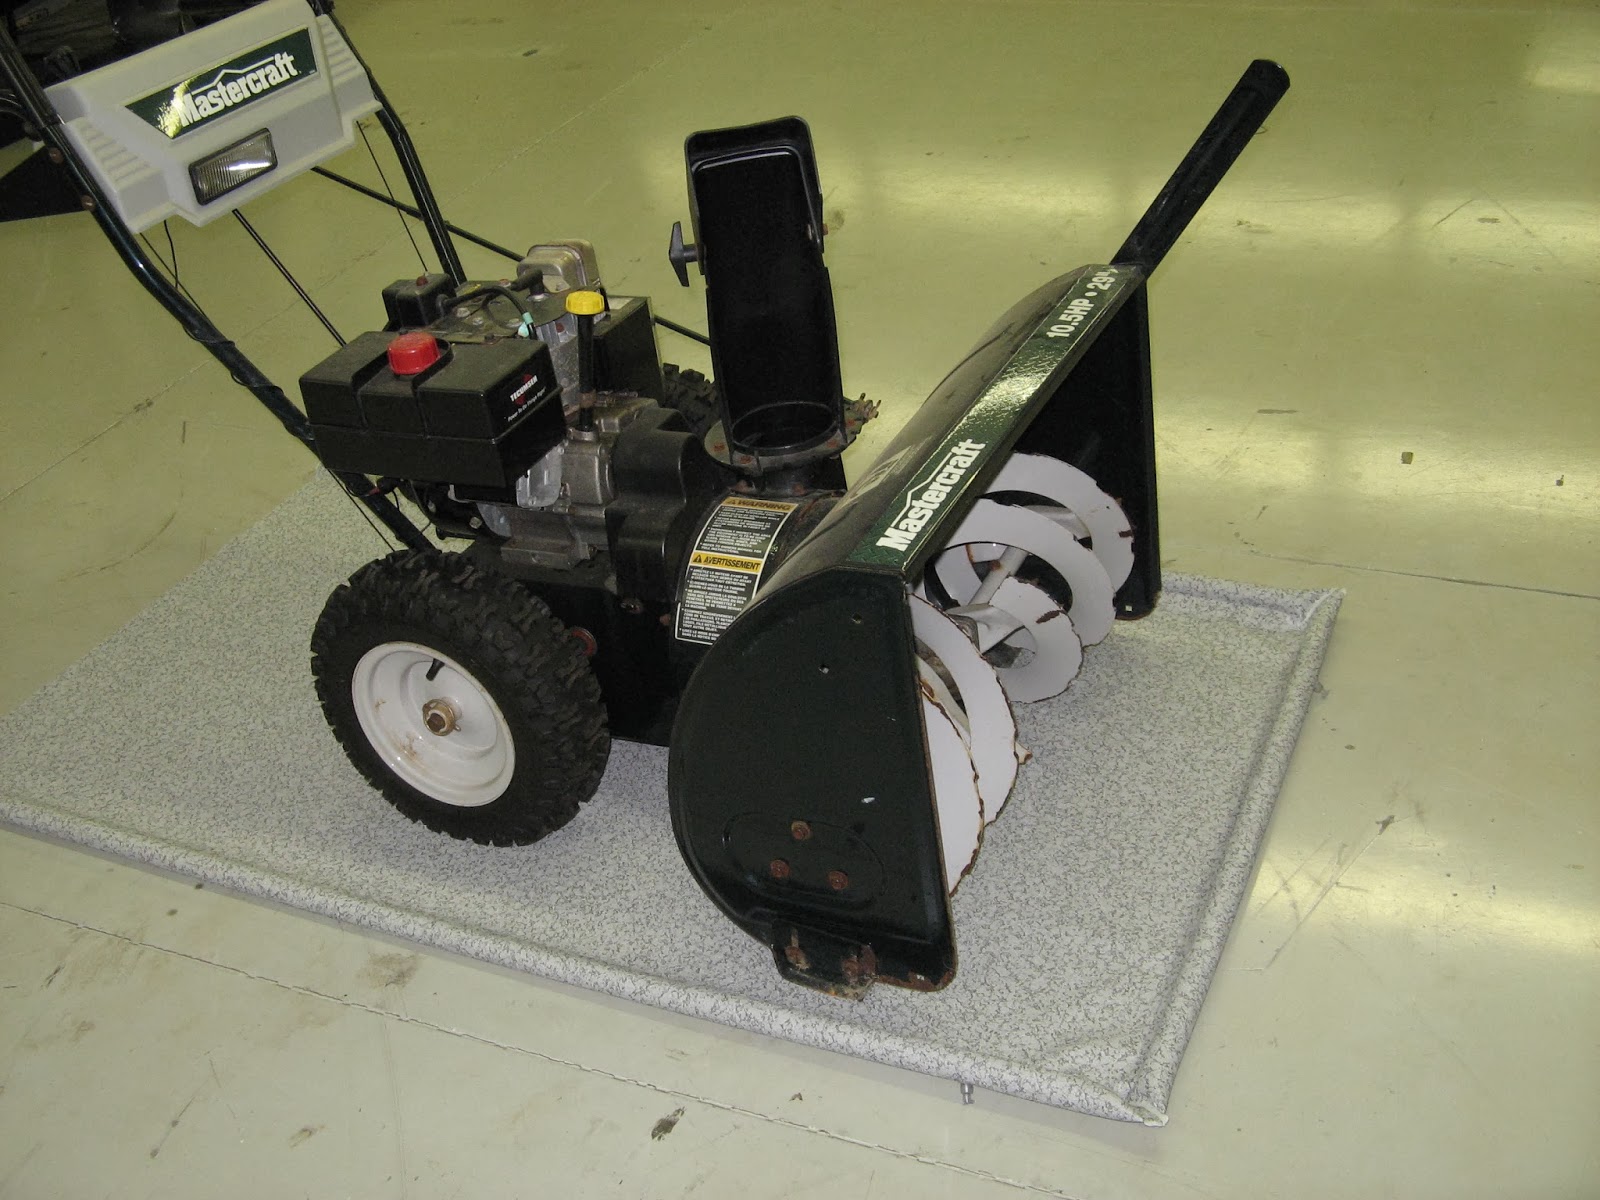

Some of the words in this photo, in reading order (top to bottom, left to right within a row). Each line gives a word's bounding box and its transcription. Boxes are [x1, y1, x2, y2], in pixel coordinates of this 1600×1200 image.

[180, 52, 299, 127] Mastercraft
[1046, 298, 1095, 338] 10.5HP
[738, 499, 792, 511] WARNING
[876, 438, 986, 552] Mastercraft
[704, 555, 761, 571] AVERTISSEMENT
